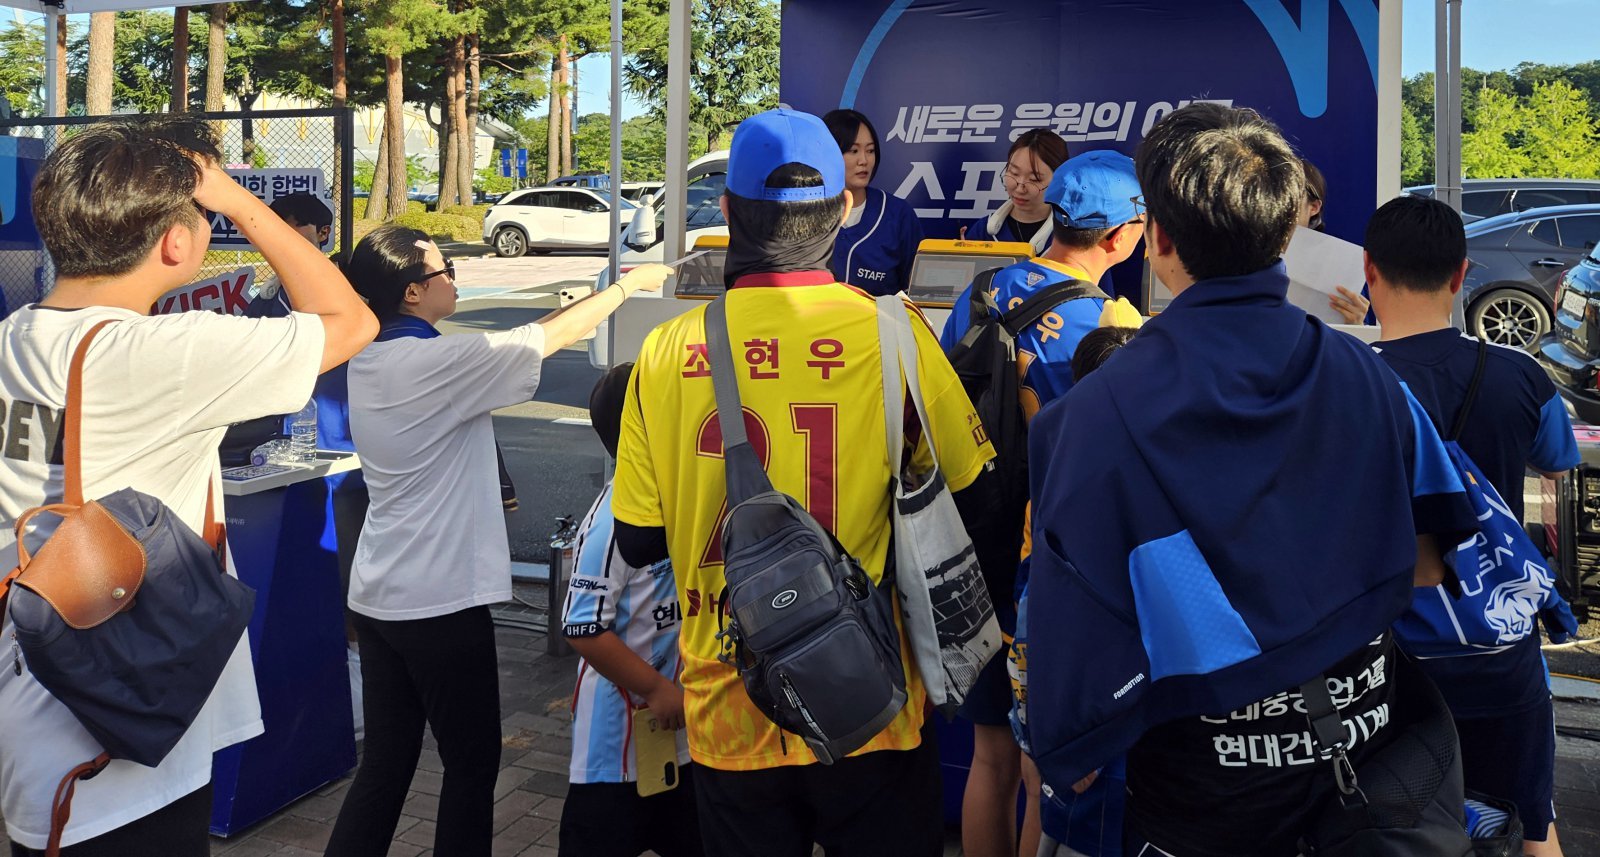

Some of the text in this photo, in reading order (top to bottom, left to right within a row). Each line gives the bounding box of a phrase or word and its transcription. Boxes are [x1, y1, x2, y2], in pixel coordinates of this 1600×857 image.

[886, 103, 1003, 144] 새로운
[1009, 101, 1137, 143] 응원의
[857, 268, 886, 282] STAFF
[566, 623, 597, 637] UHFC
[651, 600, 683, 632] 현
[1113, 672, 1145, 700] FORMOTION
[1200, 654, 1386, 724] 대중업그룹
[1212, 703, 1390, 768] 현대건기계
